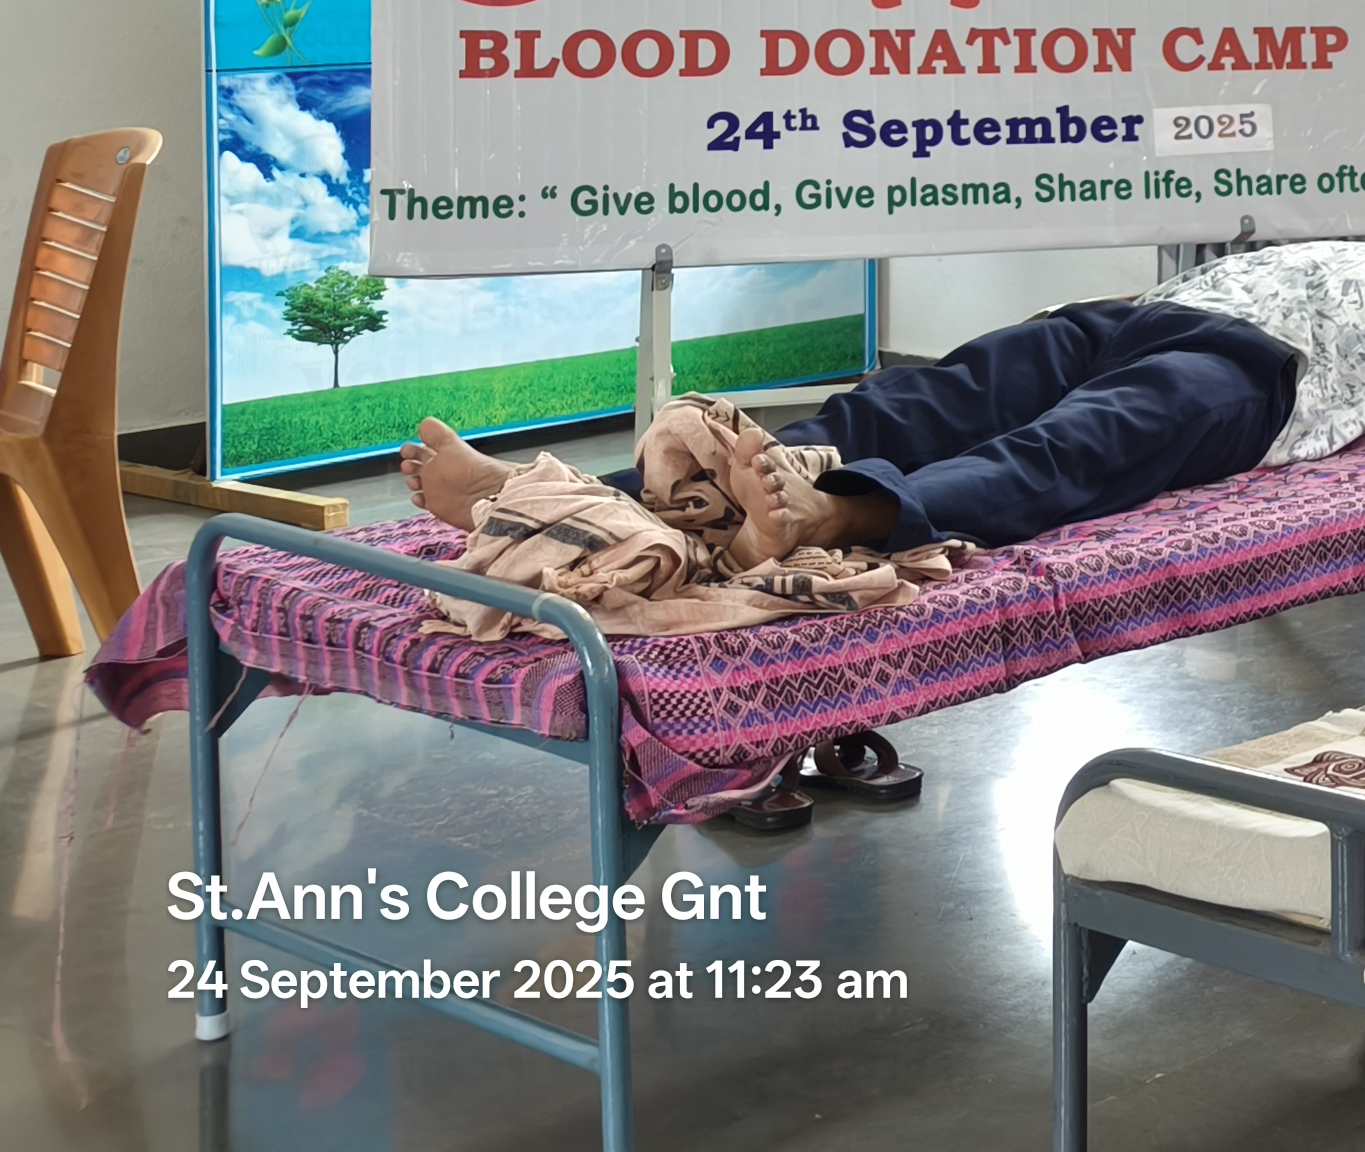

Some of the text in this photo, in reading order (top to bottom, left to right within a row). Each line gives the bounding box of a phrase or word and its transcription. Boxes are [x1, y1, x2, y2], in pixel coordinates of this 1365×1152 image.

[457, 25, 1349, 79] BLOOD DONATION CAMP
[706, 104, 1258, 158] 24th September 2025
[379, 186, 528, 221] Theme:
[569, 183, 656, 218] Give
[667, 180, 782, 216] blood,
[795, 178, 875, 212] Give
[887, 174, 1022, 215] plasma,
[1034, 171, 1133, 205] Share
[1143, 168, 1203, 204] life,
[1213, 166, 1307, 199] Share
